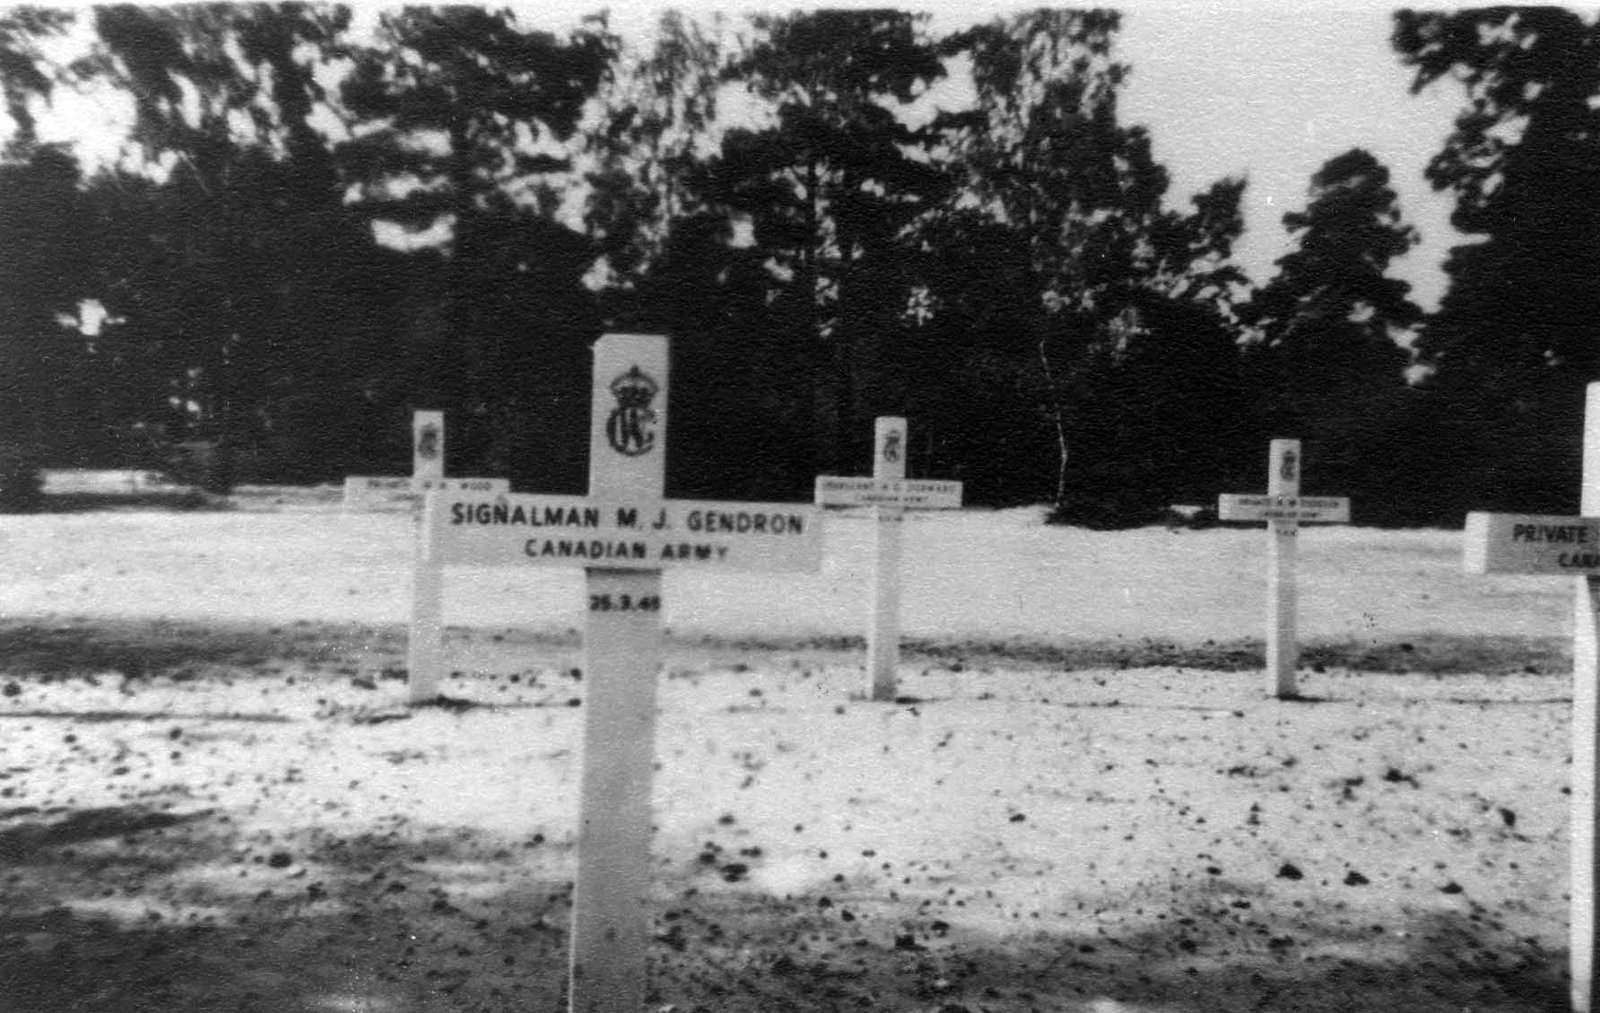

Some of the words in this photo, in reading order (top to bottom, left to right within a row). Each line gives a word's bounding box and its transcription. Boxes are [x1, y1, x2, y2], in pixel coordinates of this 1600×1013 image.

[450, 502, 599, 528] SIGNALMAN
[686, 510, 802, 535] GENDRON
[1513, 523, 1589, 544] PRIVATE
[525, 538, 647, 560] CANADIAN
[661, 542, 728, 561] ARMY
